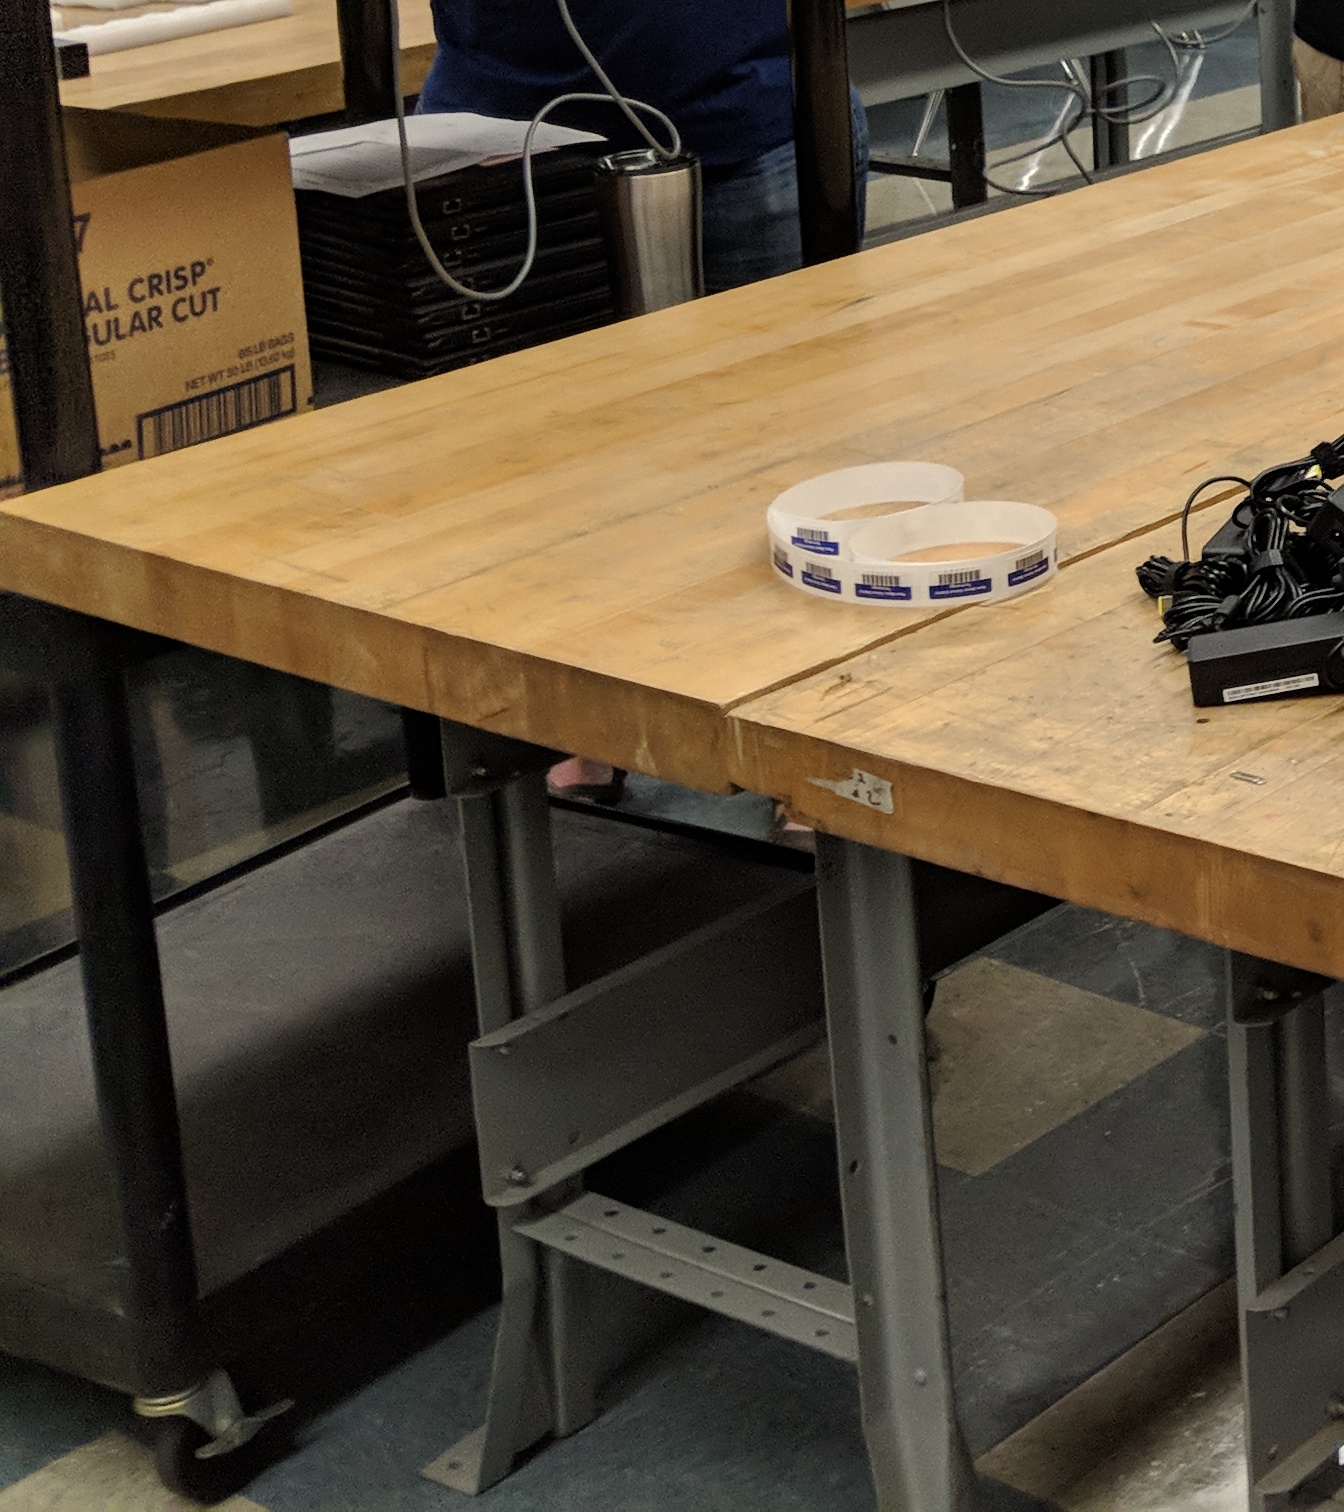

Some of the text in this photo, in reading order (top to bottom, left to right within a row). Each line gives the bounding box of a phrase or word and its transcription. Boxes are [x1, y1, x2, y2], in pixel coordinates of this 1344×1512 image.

[84, 287, 119, 315] AL
[86, 287, 221, 346] ULAR CUT
[184, 375, 207, 392] NET
[208, 370, 224, 384] WT
